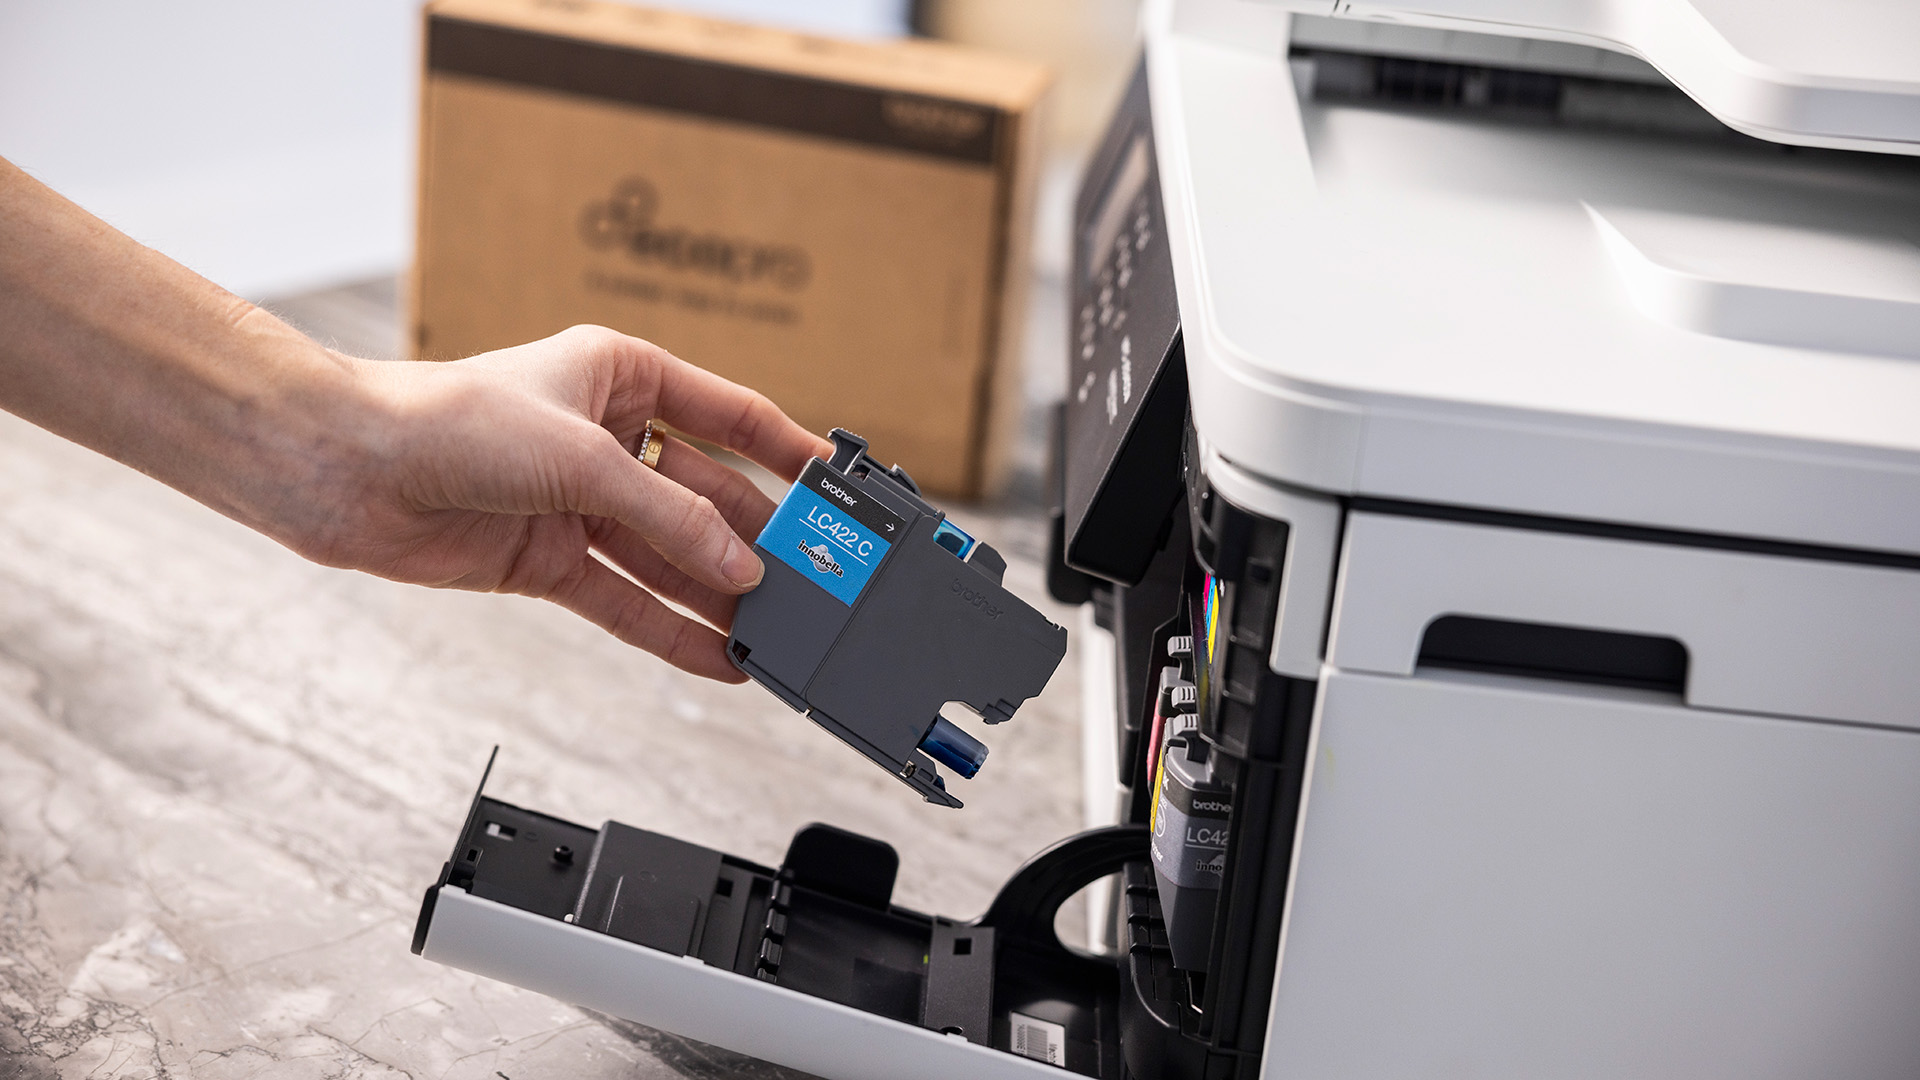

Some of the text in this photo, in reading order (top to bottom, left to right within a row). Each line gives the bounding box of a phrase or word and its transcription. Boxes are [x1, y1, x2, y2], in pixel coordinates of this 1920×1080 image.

[821, 477, 857, 506] brother
[807, 506, 873, 557] LC422 C
[797, 539, 844, 578] innobella
[951, 578, 1004, 620] brother
[1192, 799, 1232, 812] brothe
[1187, 827, 1230, 845] LC42
